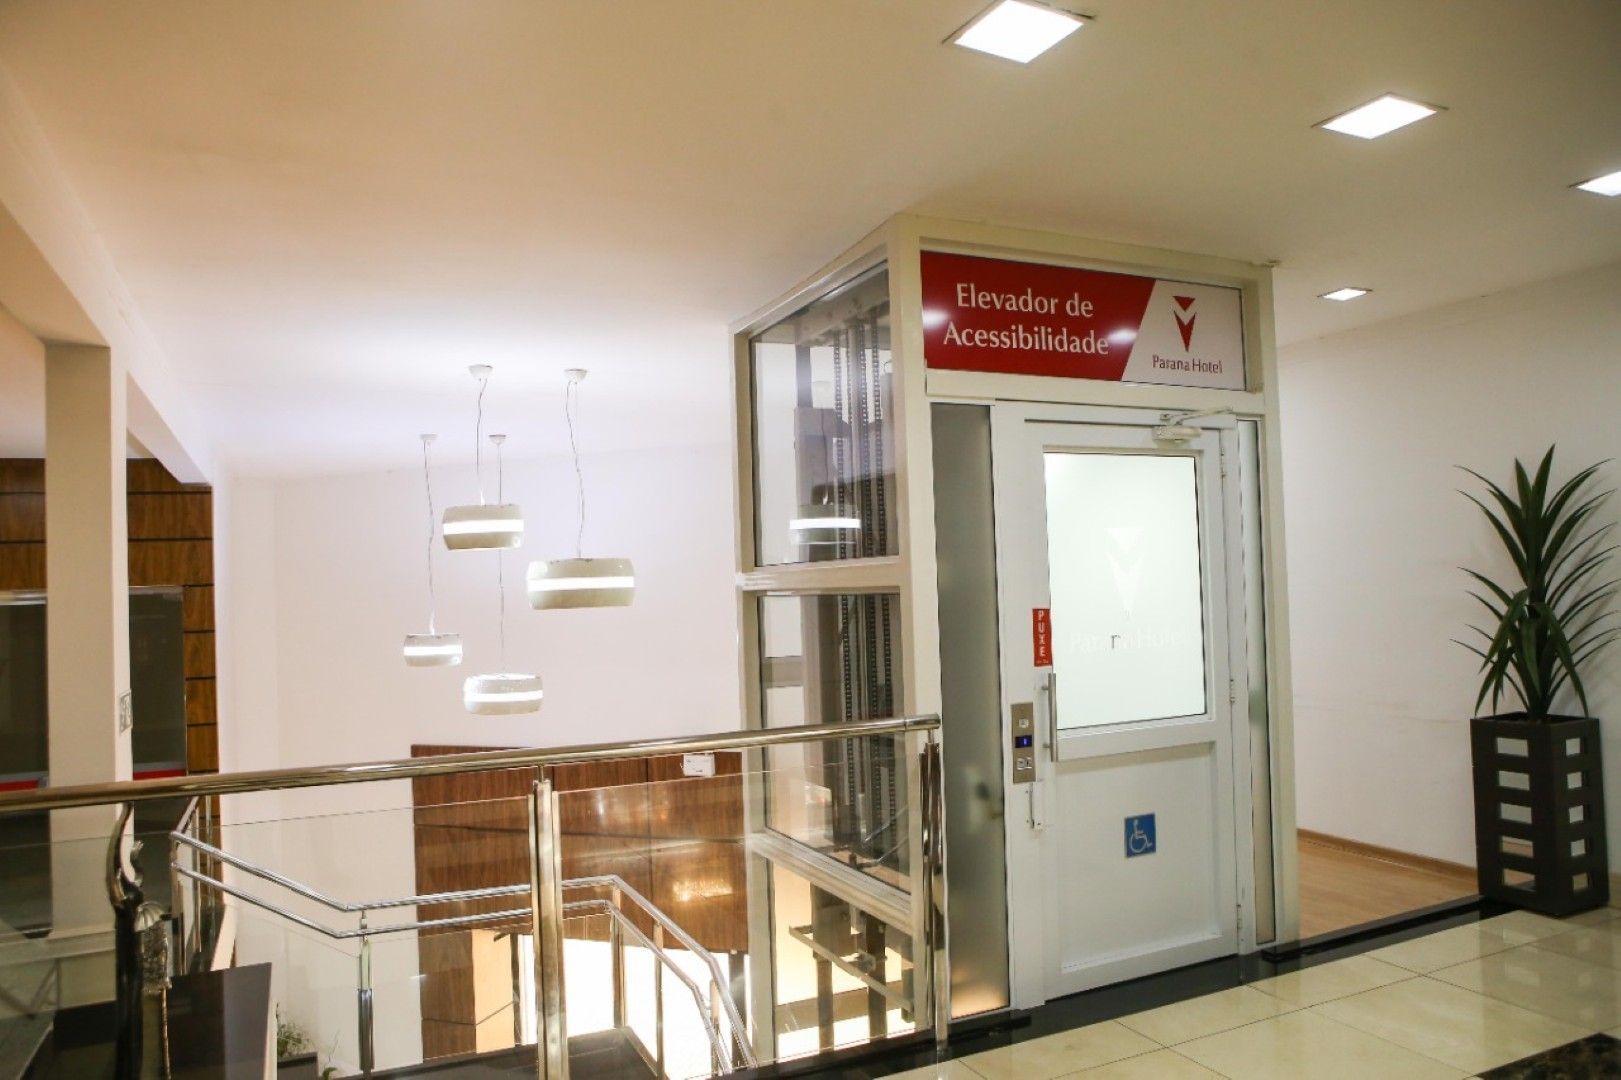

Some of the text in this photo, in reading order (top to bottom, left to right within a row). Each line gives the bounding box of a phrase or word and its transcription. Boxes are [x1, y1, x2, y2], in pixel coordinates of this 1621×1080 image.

[956, 283, 1094, 318] Elevador de
[943, 322, 1110, 355] Acessibilidade
[1152, 354, 1223, 374] Parana Hotel
[1037, 610, 1046, 657] PUXE
